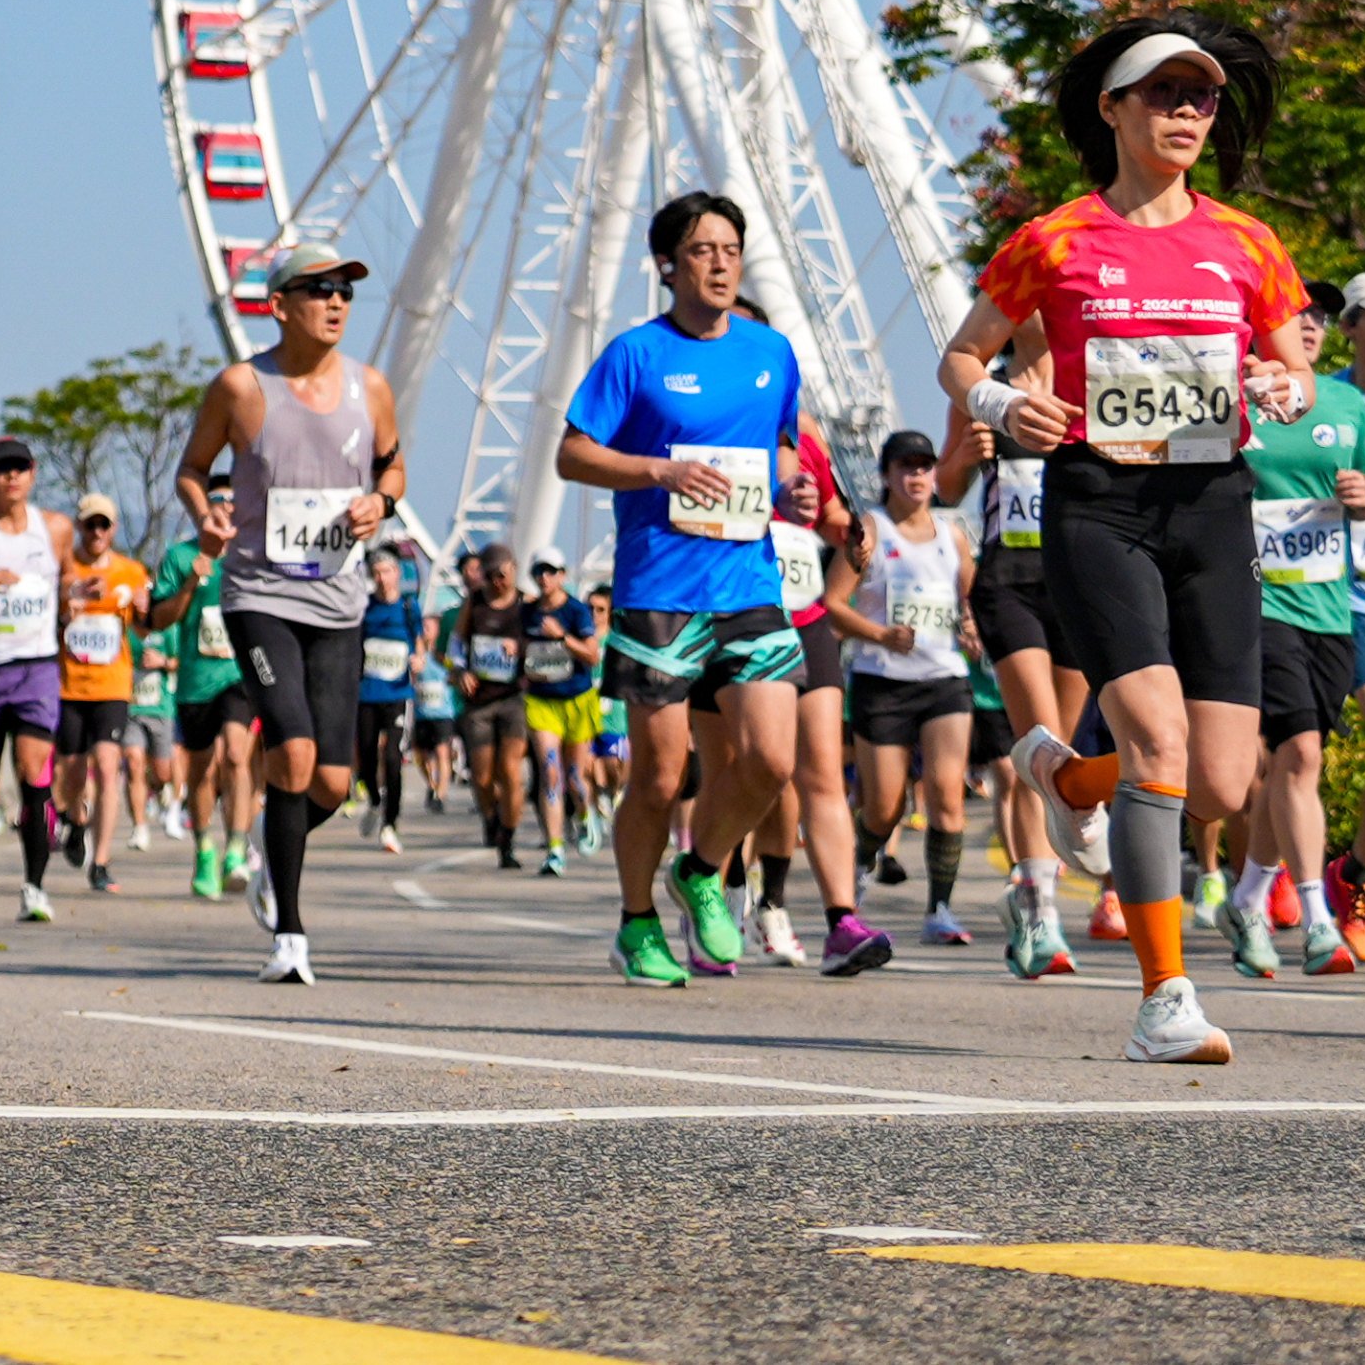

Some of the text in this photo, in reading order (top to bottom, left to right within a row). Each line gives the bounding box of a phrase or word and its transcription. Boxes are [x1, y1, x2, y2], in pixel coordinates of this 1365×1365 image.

[1135, 312, 1186, 320] GUANGZHOU
[1096, 385, 1231, 427] G5430
[1261, 528, 1341, 560] A6905
